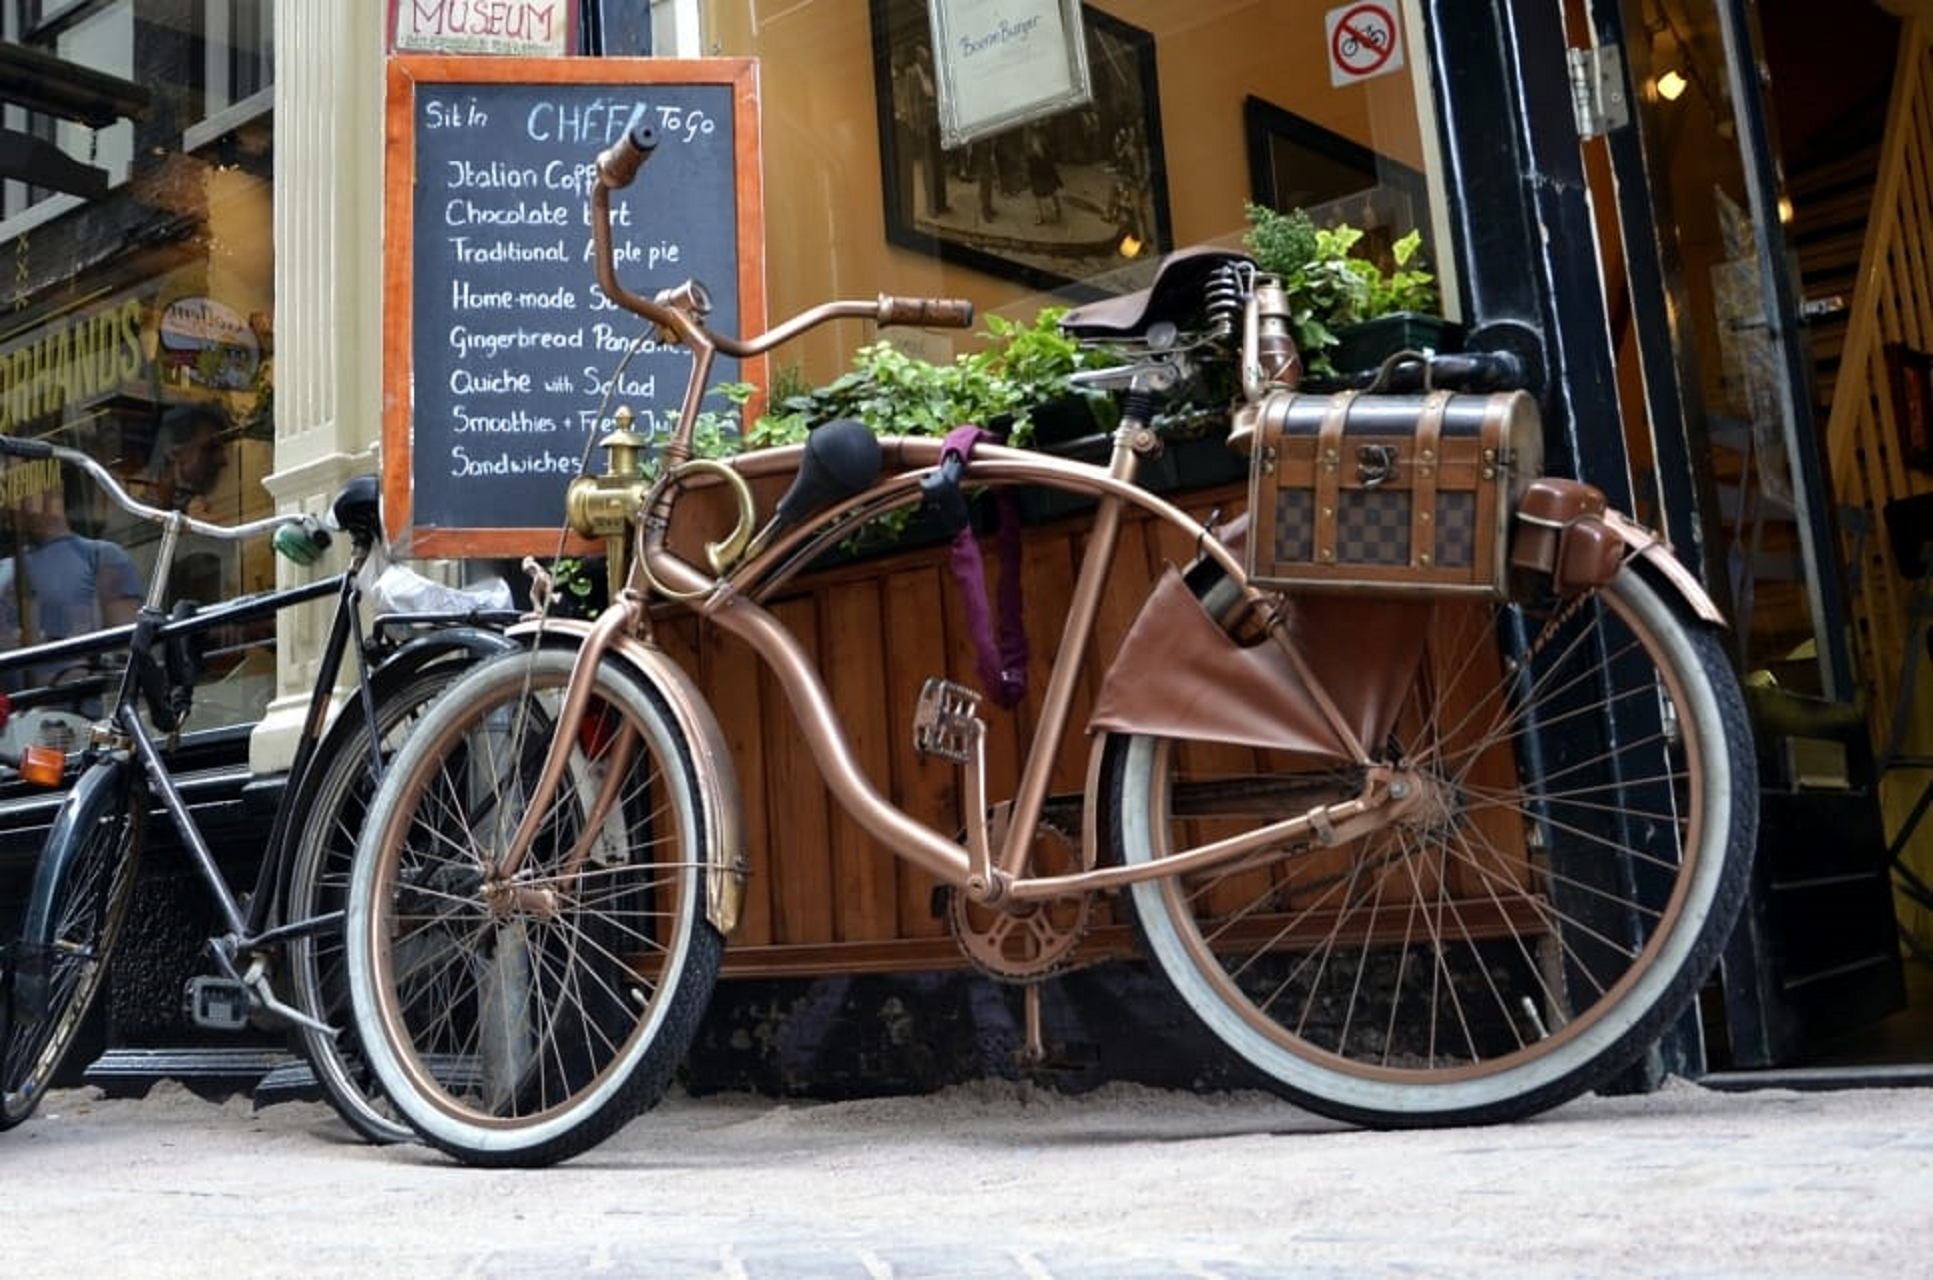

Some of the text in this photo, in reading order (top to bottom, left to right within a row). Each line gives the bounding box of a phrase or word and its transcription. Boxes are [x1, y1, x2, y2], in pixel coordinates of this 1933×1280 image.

[412, 0, 554, 41] MUSEUM
[426, 101, 462, 129] Sit
[655, 107, 715, 143] To Go
[447, 160, 598, 196] Italian Coff
[445, 199, 632, 227] Chocolate trt
[448, 237, 680, 269] Traditional Aple pie
[452, 281, 576, 311] Home-made
[449, 326, 583, 358] Gingerbread
[450, 366, 655, 398] Quiche with Salad
[452, 406, 556, 433] Smoothies
[451, 446, 582, 478] Sandwiches
